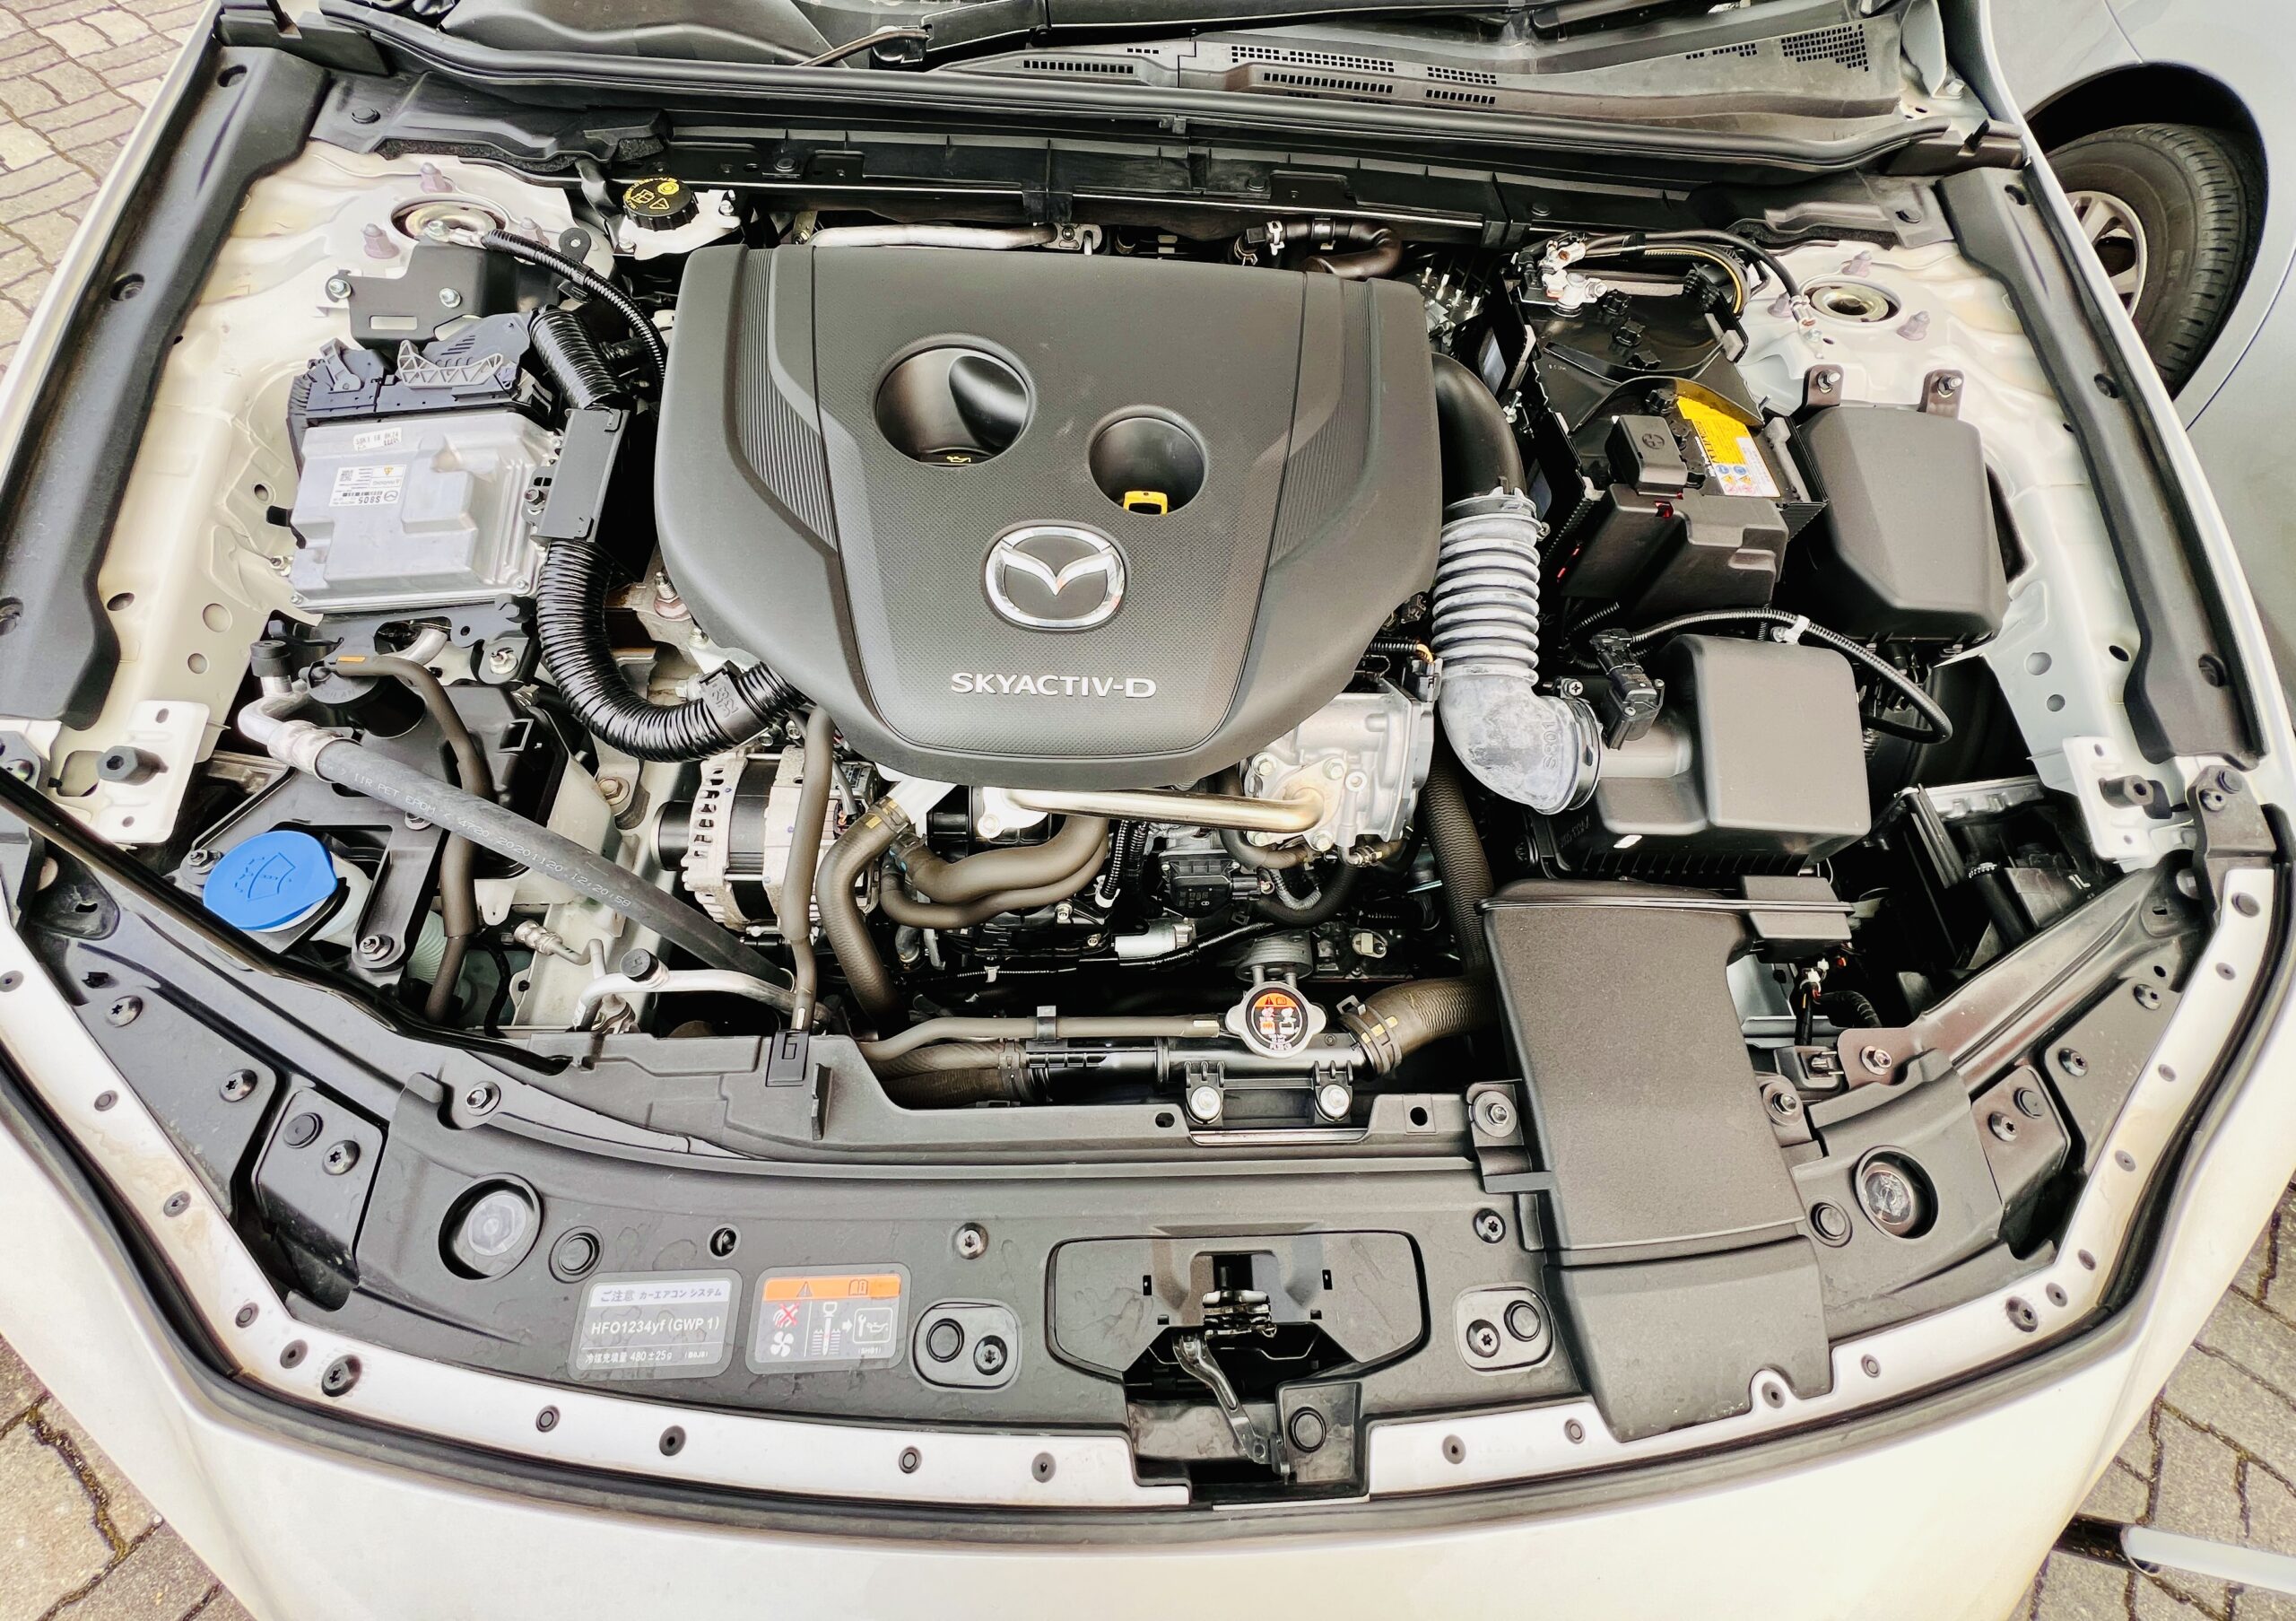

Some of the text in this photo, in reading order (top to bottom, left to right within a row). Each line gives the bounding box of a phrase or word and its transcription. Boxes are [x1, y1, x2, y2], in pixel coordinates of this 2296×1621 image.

[358, 495, 382, 504] S805
[951, 672, 1157, 699] SKYACTIV-D
[378, 782, 400, 797] PET
[404, 795, 437, 815] EPDM
[496, 835, 564, 873] 20201120
[601, 1290, 635, 1302] ご注意
[591, 1315, 720, 1335] HFO1234yf (GWP 1)
